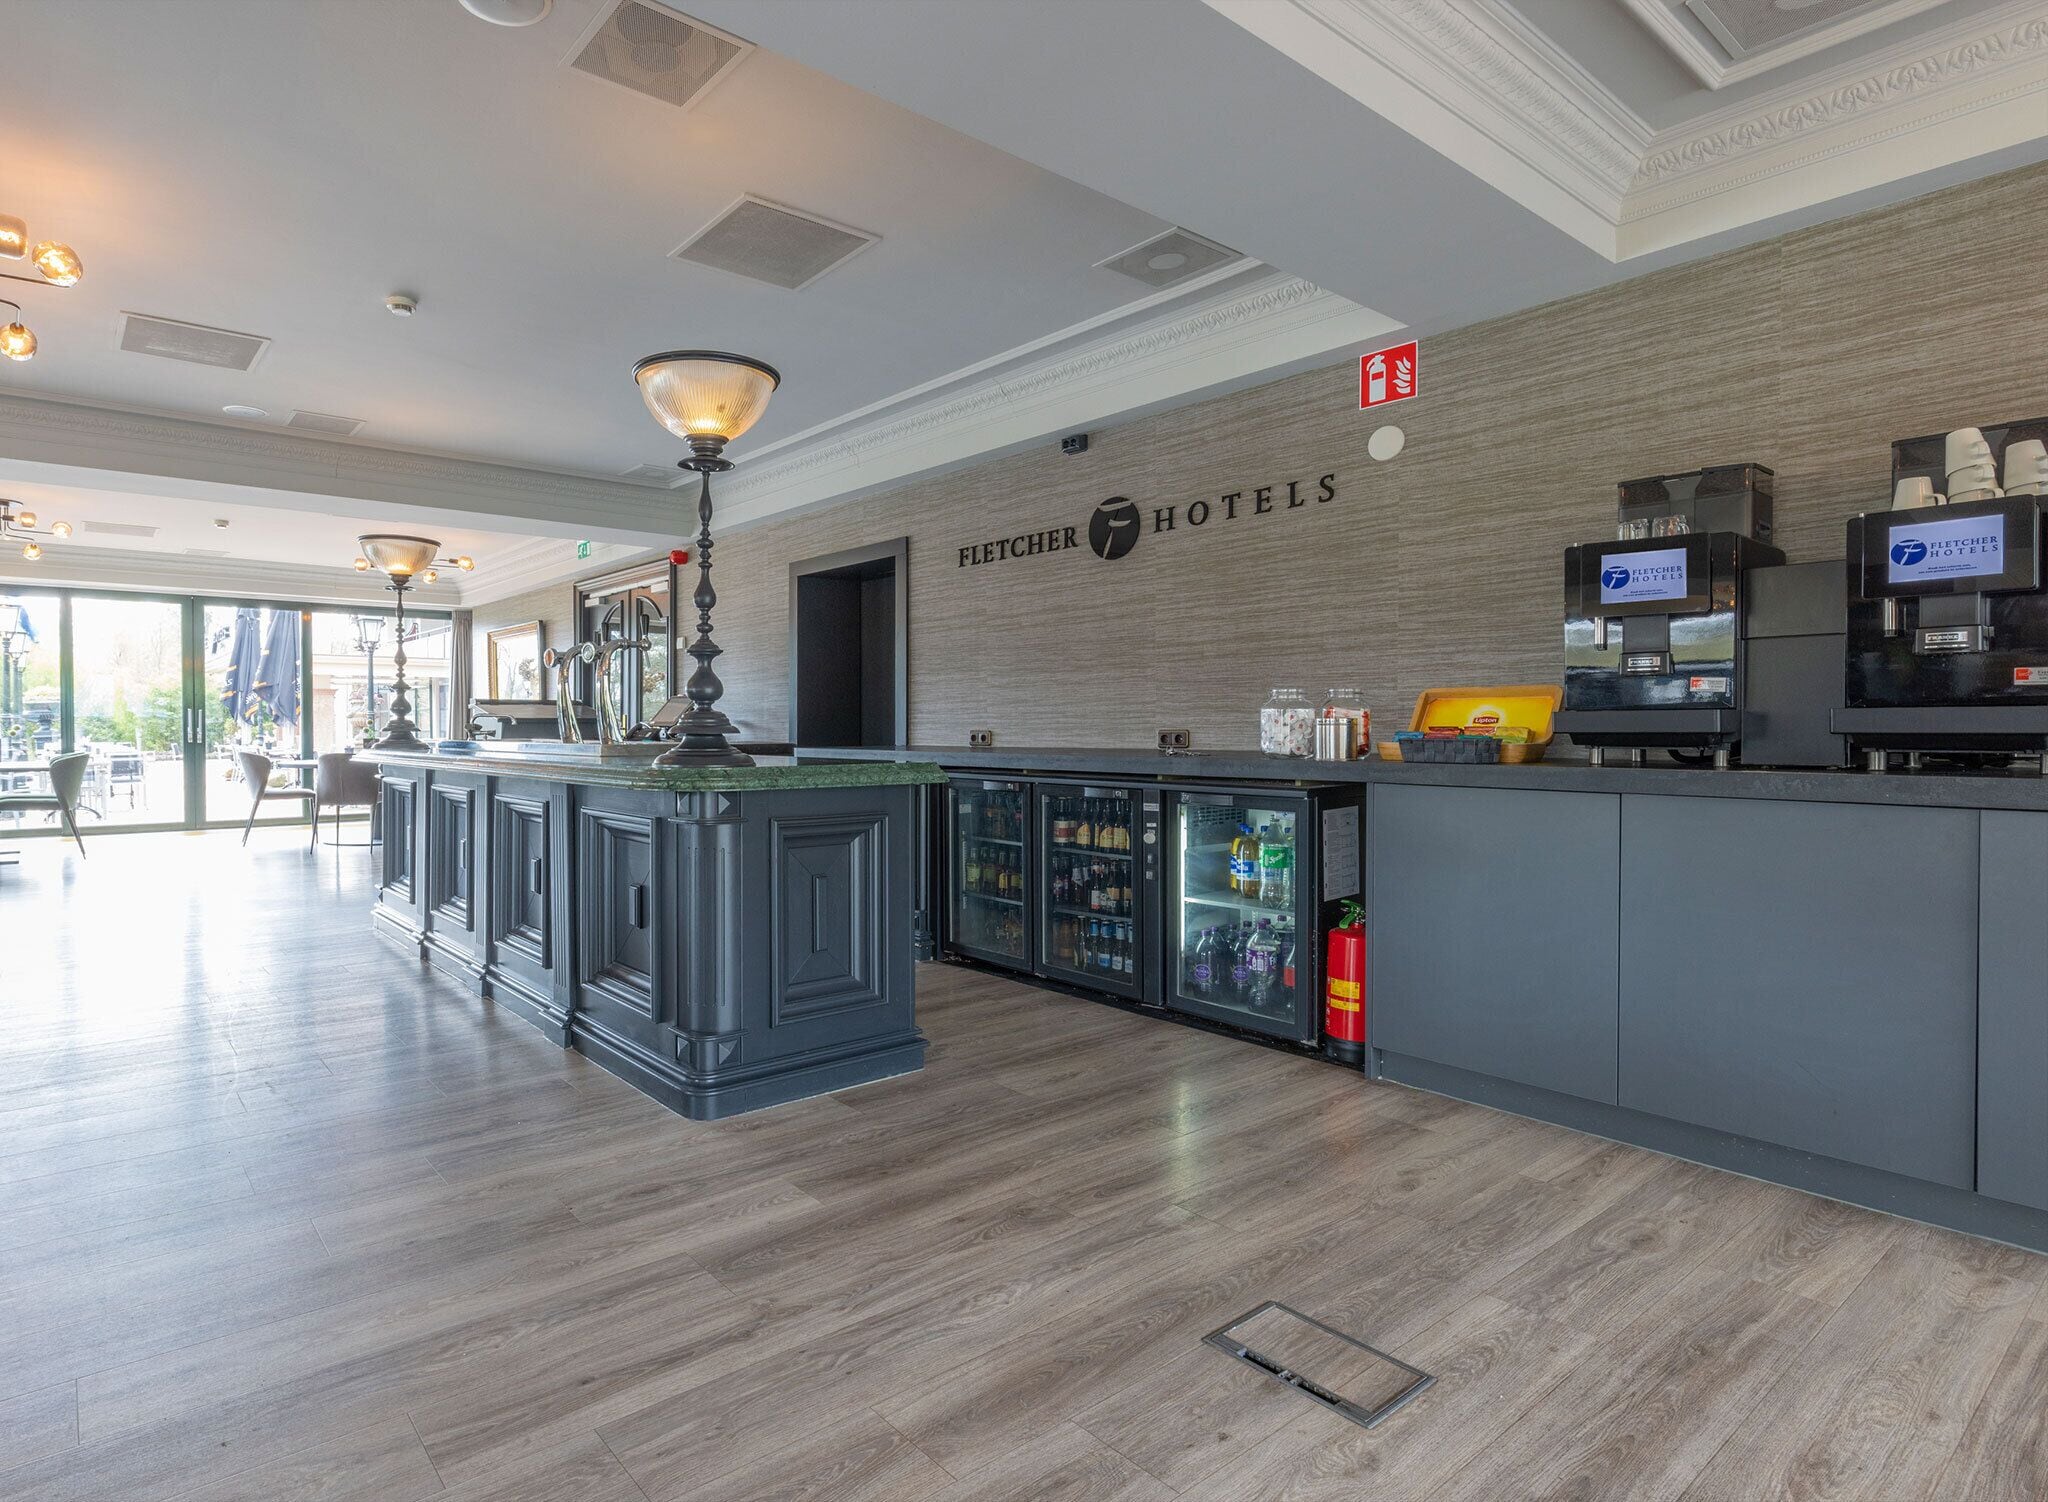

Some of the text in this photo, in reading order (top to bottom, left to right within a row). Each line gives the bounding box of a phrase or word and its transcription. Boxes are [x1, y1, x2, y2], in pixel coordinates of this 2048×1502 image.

[958, 526, 1079, 568] FLETCHER
[1153, 474, 1336, 533] HOTELS
[1931, 536, 1998, 549] FLETCHER
[1930, 544, 1999, 557] HOTELS
[1632, 565, 1682, 576] FLETCHER
[1632, 573, 1683, 583] HOTELS
